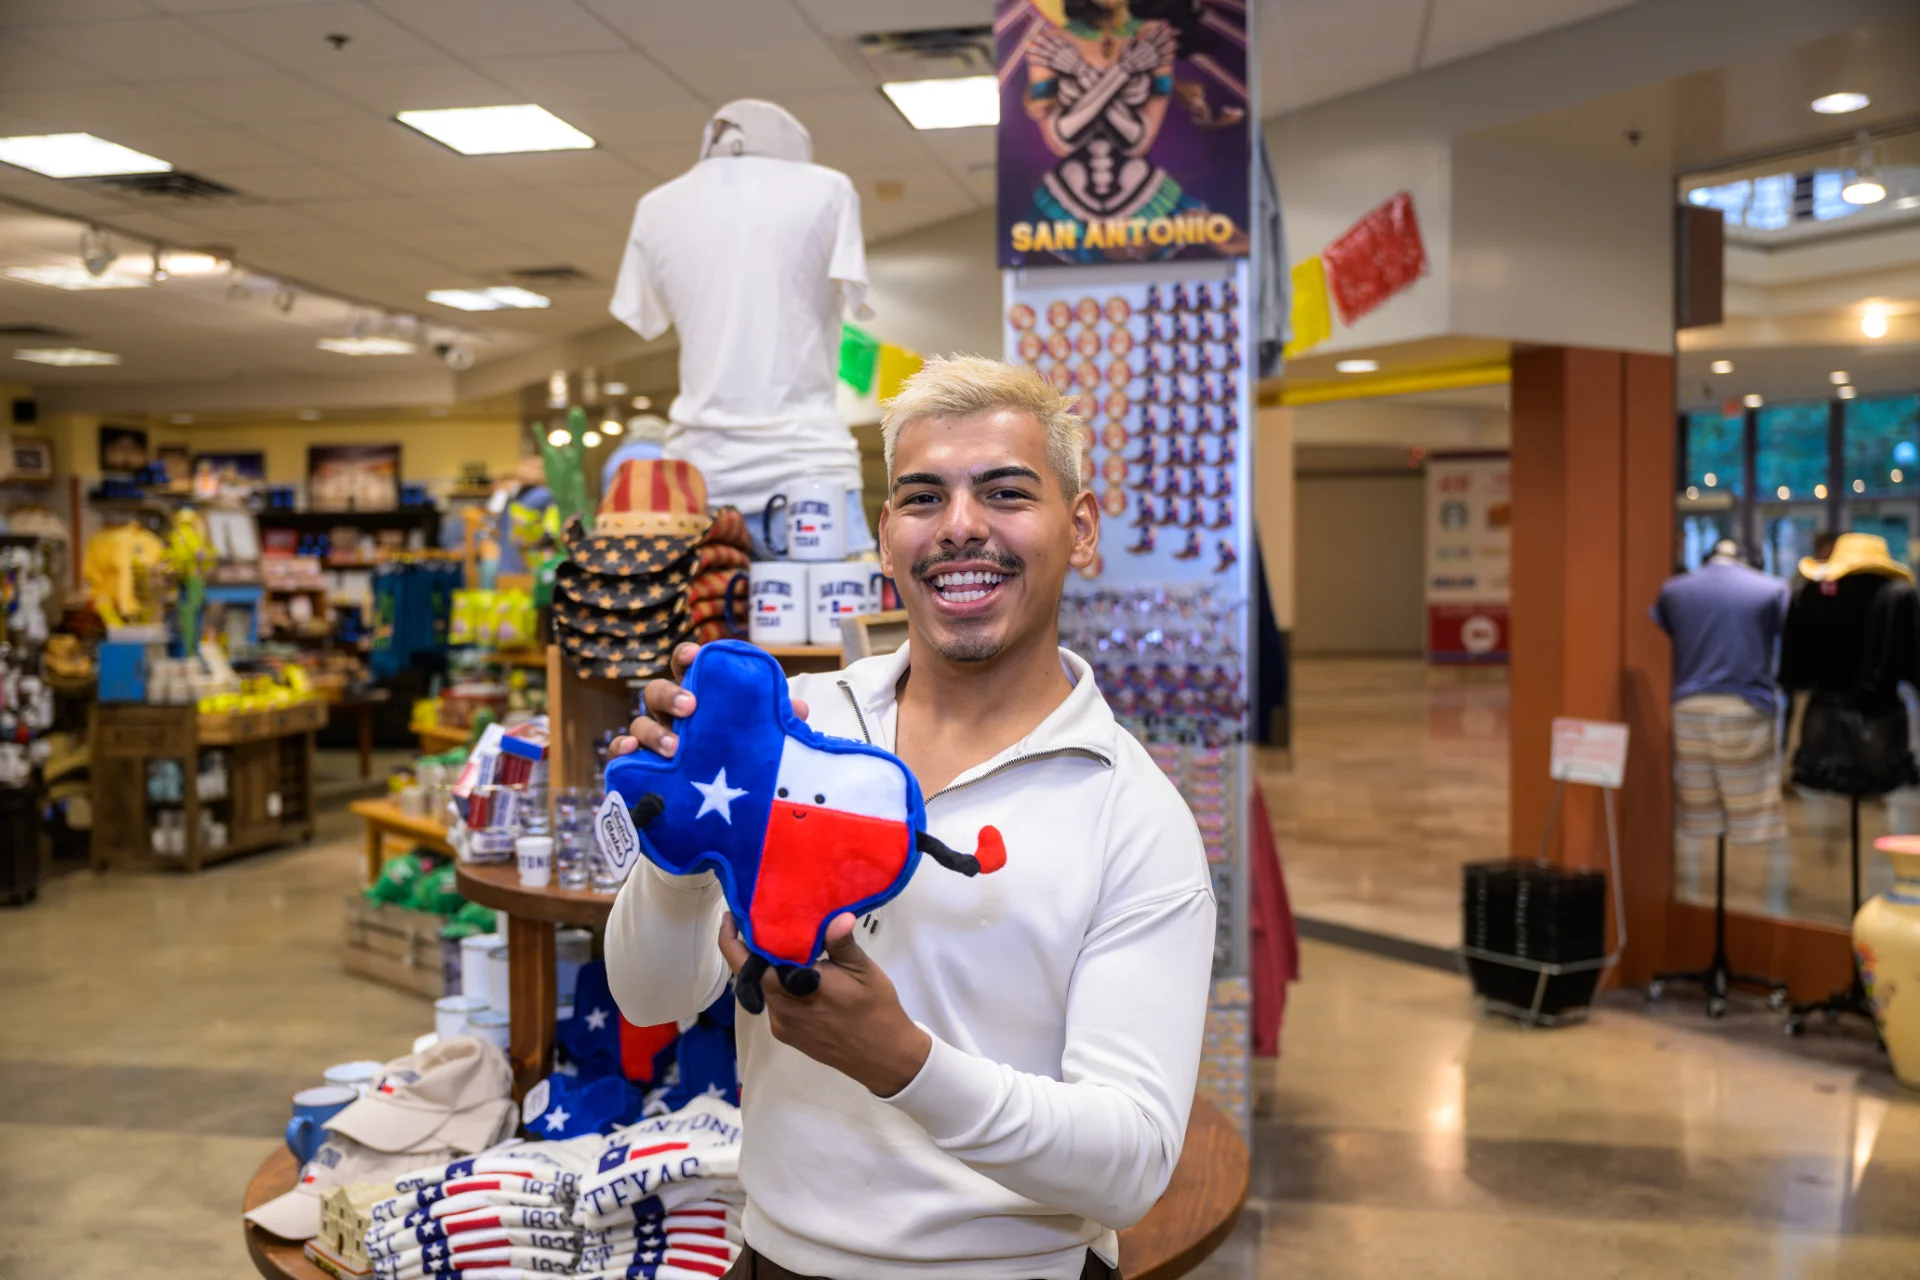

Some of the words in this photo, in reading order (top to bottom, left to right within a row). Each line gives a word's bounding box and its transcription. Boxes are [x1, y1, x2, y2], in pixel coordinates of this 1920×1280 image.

[1011, 220, 1076, 252] SAN
[1083, 213, 1234, 249] ANTONIO
[639, 1113, 740, 1144] NTONI
